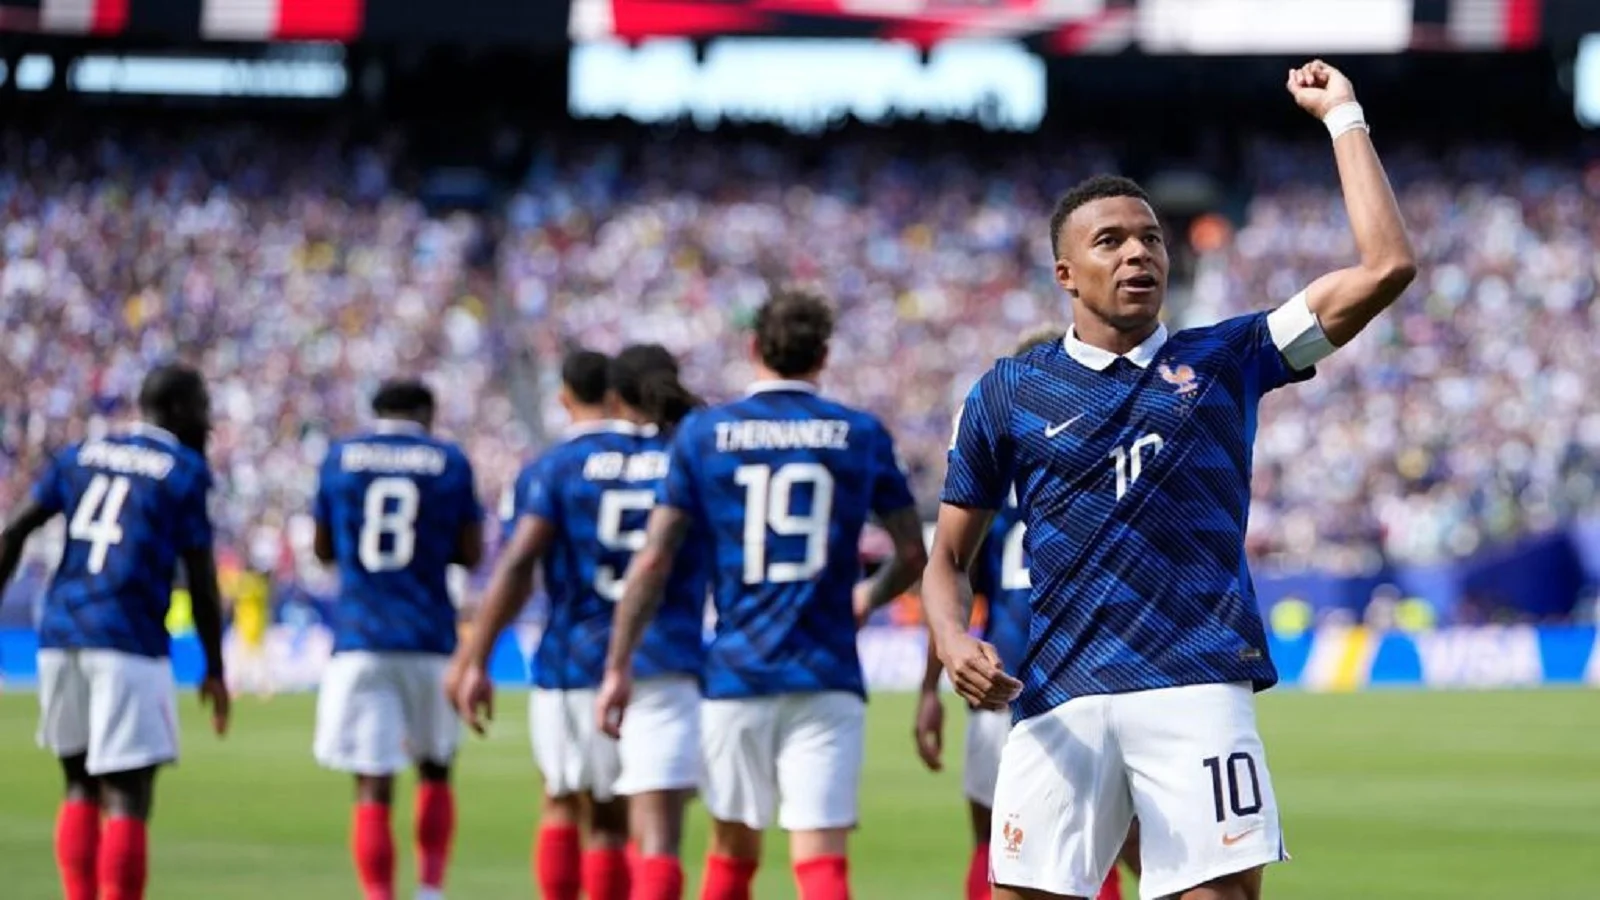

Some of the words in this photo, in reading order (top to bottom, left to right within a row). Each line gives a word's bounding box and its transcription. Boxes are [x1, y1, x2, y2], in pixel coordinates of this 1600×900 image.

[69, 475, 131, 575] 4
[359, 476, 419, 573] 8
[593, 488, 656, 602] 5
[734, 461, 835, 585] 19
[1202, 751, 1264, 823] 10
